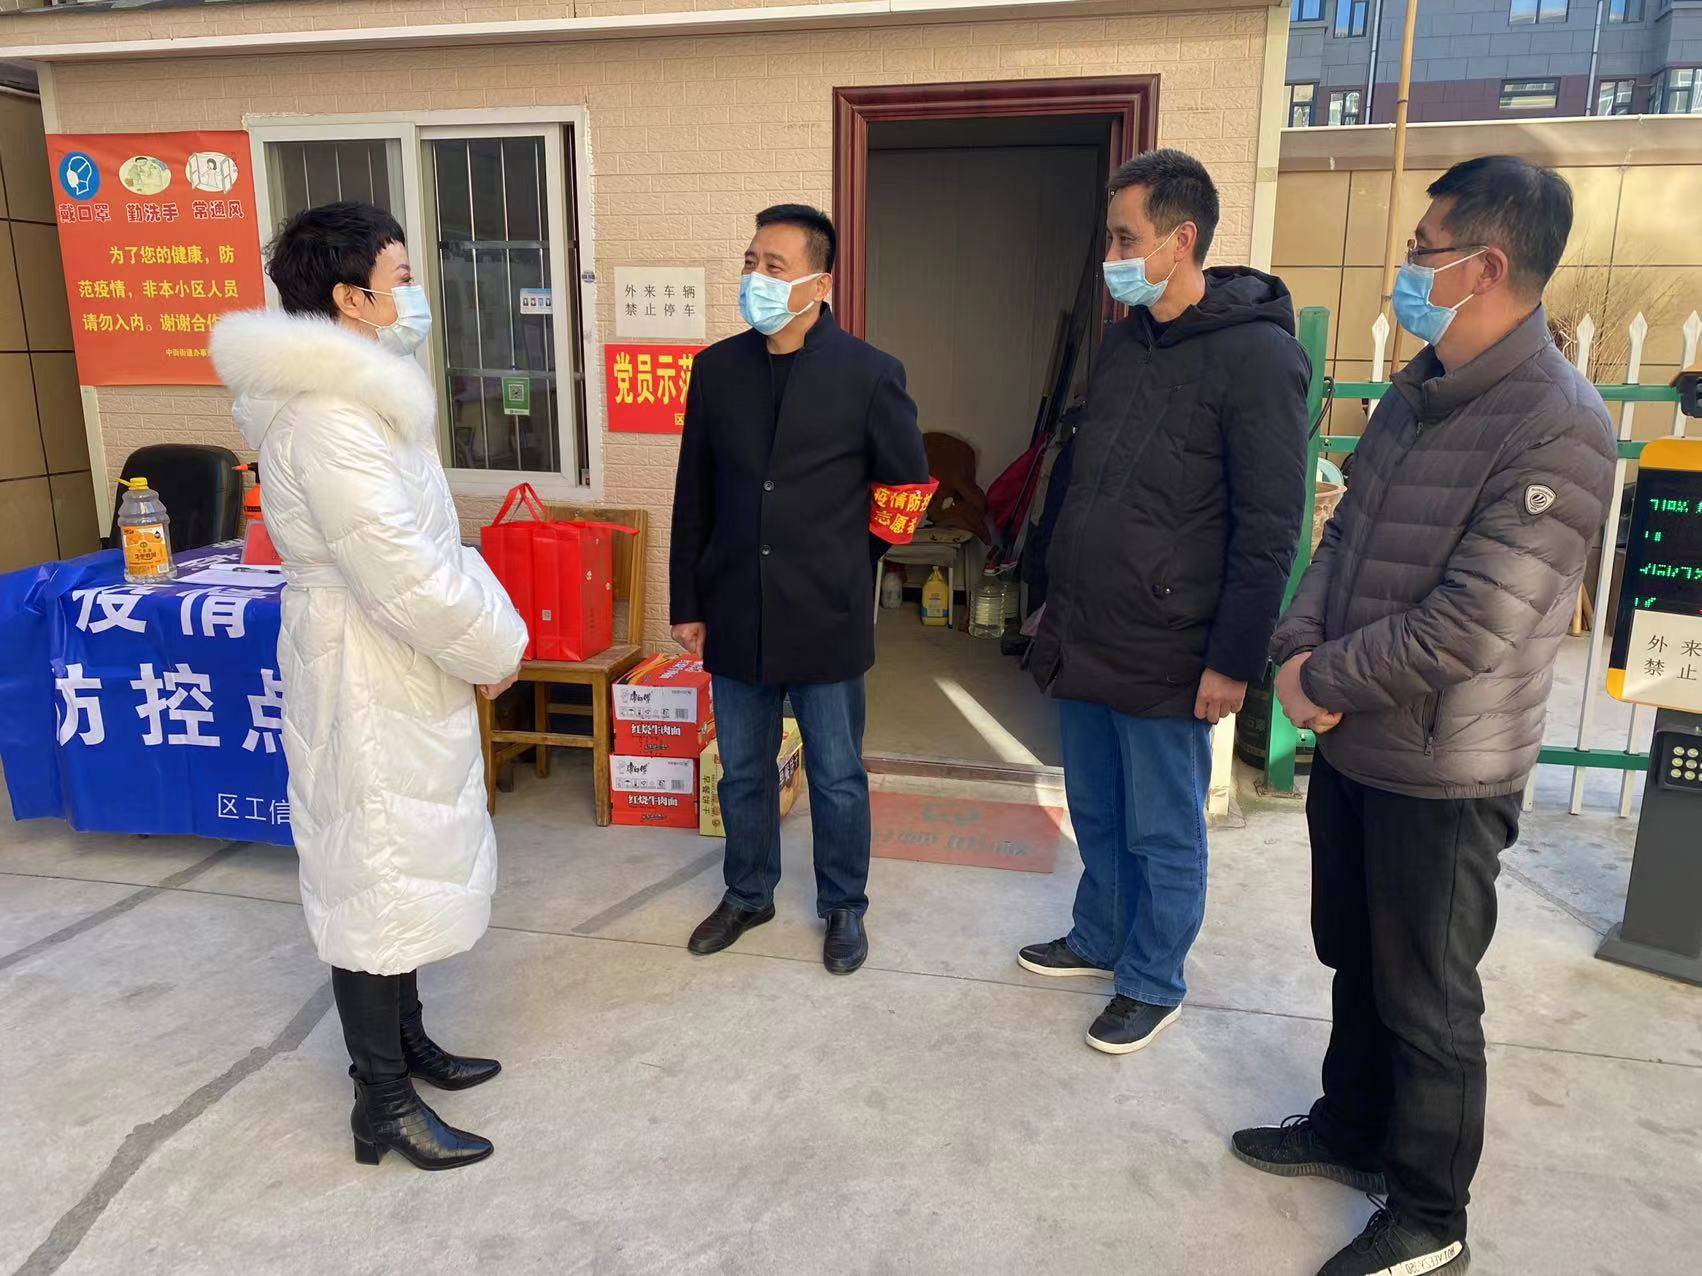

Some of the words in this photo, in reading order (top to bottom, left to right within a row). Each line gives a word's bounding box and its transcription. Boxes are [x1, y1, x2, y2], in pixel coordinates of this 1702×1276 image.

[59, 203, 111, 224] 戴口罩
[127, 203, 179, 223] 勤洗手
[192, 200, 244, 219] 常通风
[109, 245, 235, 265] 为了您的健康，防
[78, 280, 239, 299] 范疫情，非本小区人员
[624, 284, 695, 299] 外来车辆
[625, 303, 696, 317] 禁止停车
[166, 347, 210, 358] 中街街道办事
[1647, 635, 1702, 658] 外来
[1644, 658, 1697, 681] 禁止
[631, 724, 681, 736] 红烧牛肉面
[628, 795, 678, 807] 红烧牛肉面
